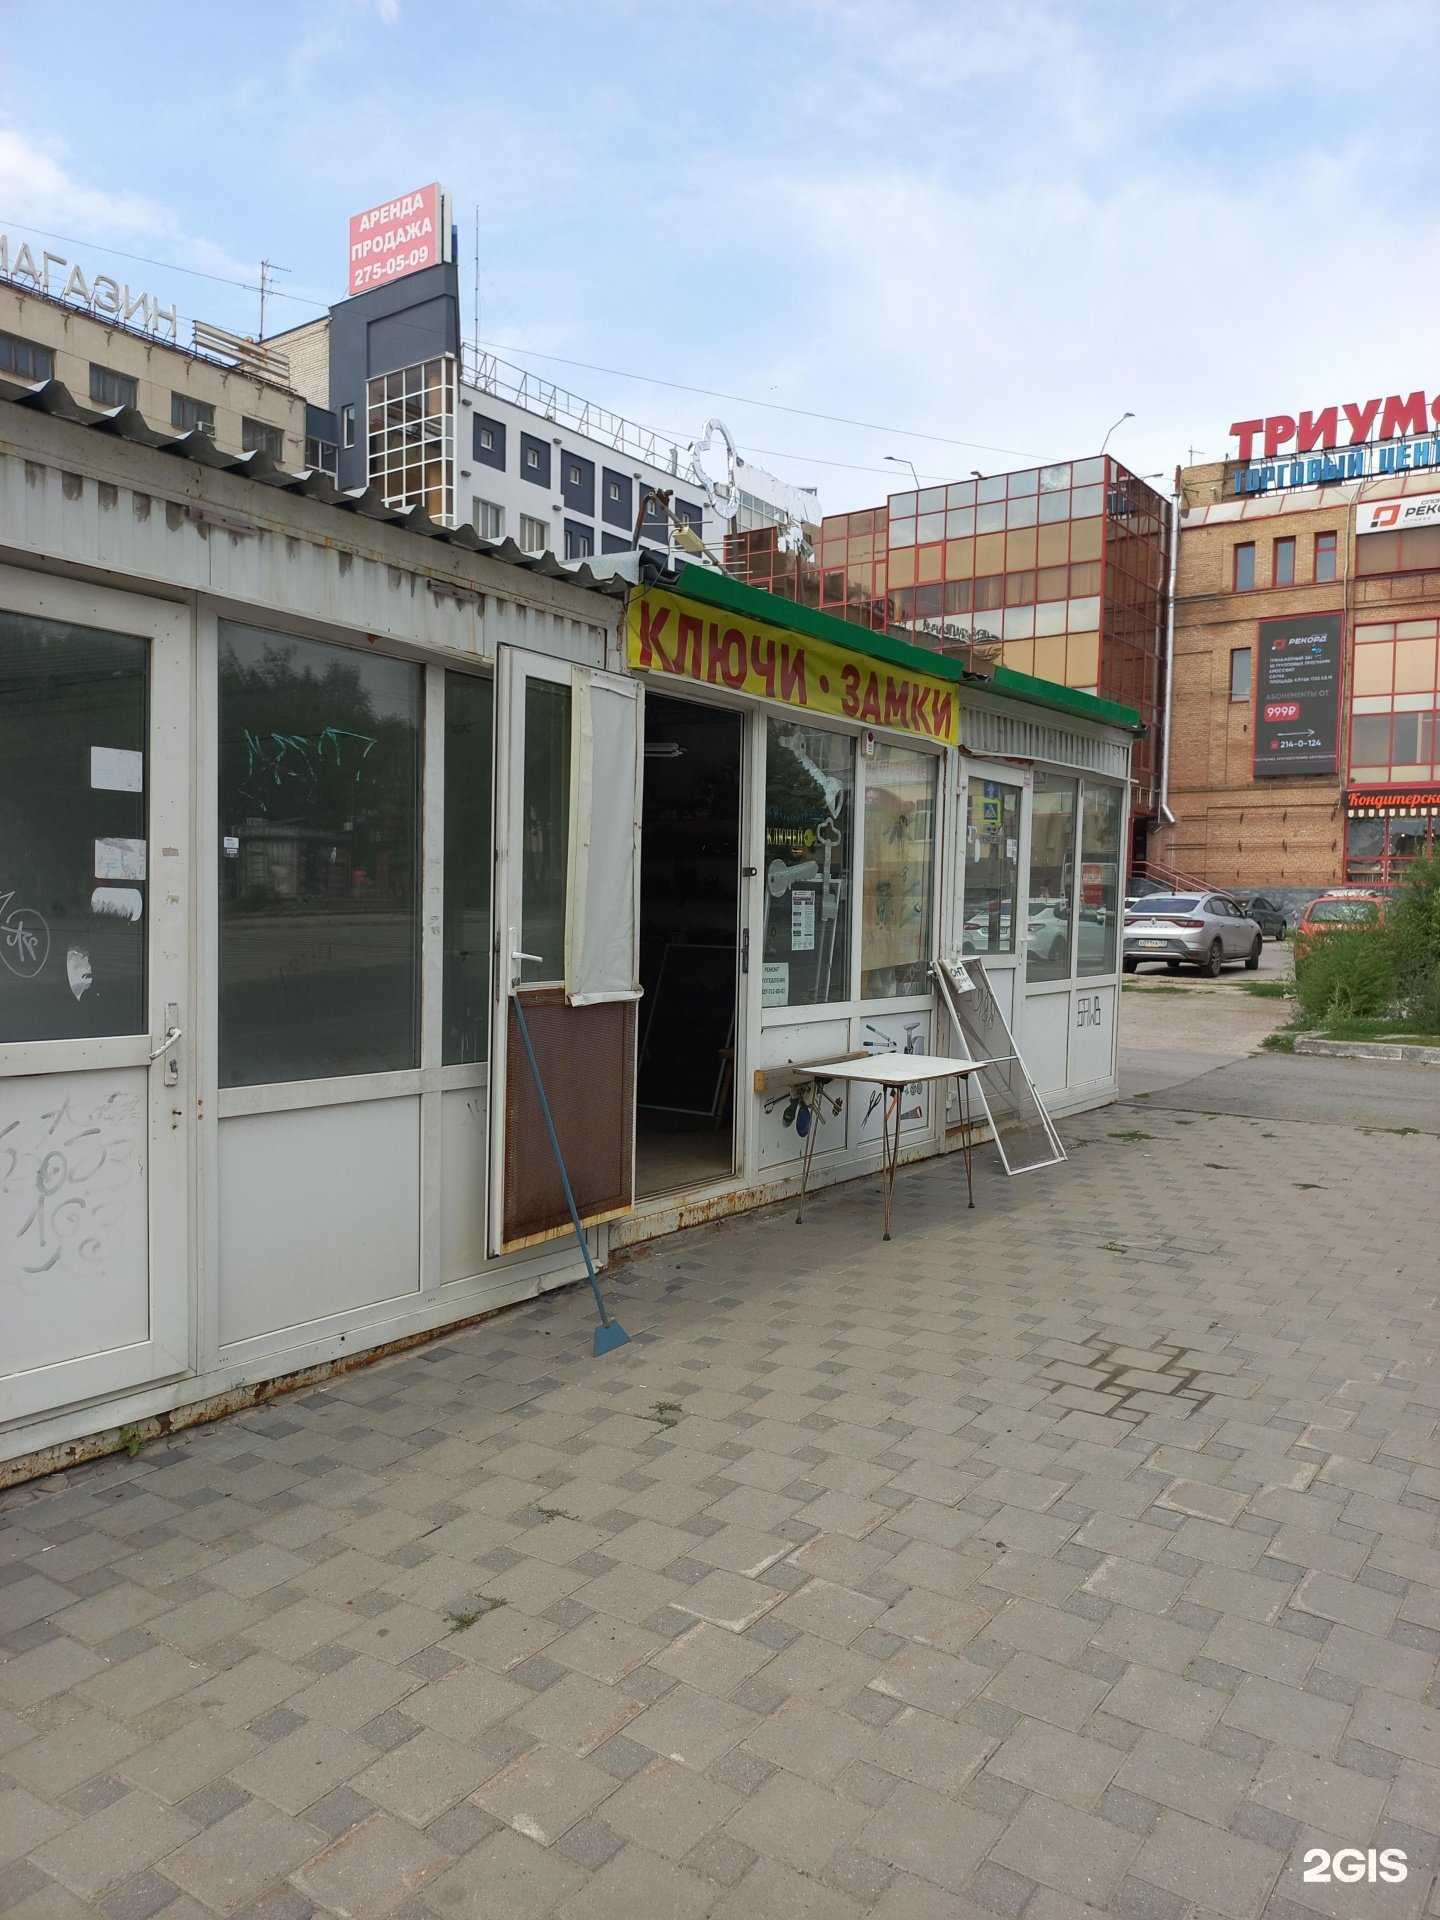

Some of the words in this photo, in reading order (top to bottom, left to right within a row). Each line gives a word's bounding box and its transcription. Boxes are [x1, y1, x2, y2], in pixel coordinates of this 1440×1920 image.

[359, 193, 424, 232] АРЕНДА
[351, 217, 432, 261] ПРОДАЖА
[355, 246, 429, 286] 275-05-09
[1233, 447, 1364, 495] ТОРГОВЫЙ
[1288, 634, 1328, 645] РЕКОРД
[638, 600, 808, 705] КЛЮЧИ
[840, 664, 953, 740] ЗАМКИ
[1280, 739, 1321, 748] 214-0-124
